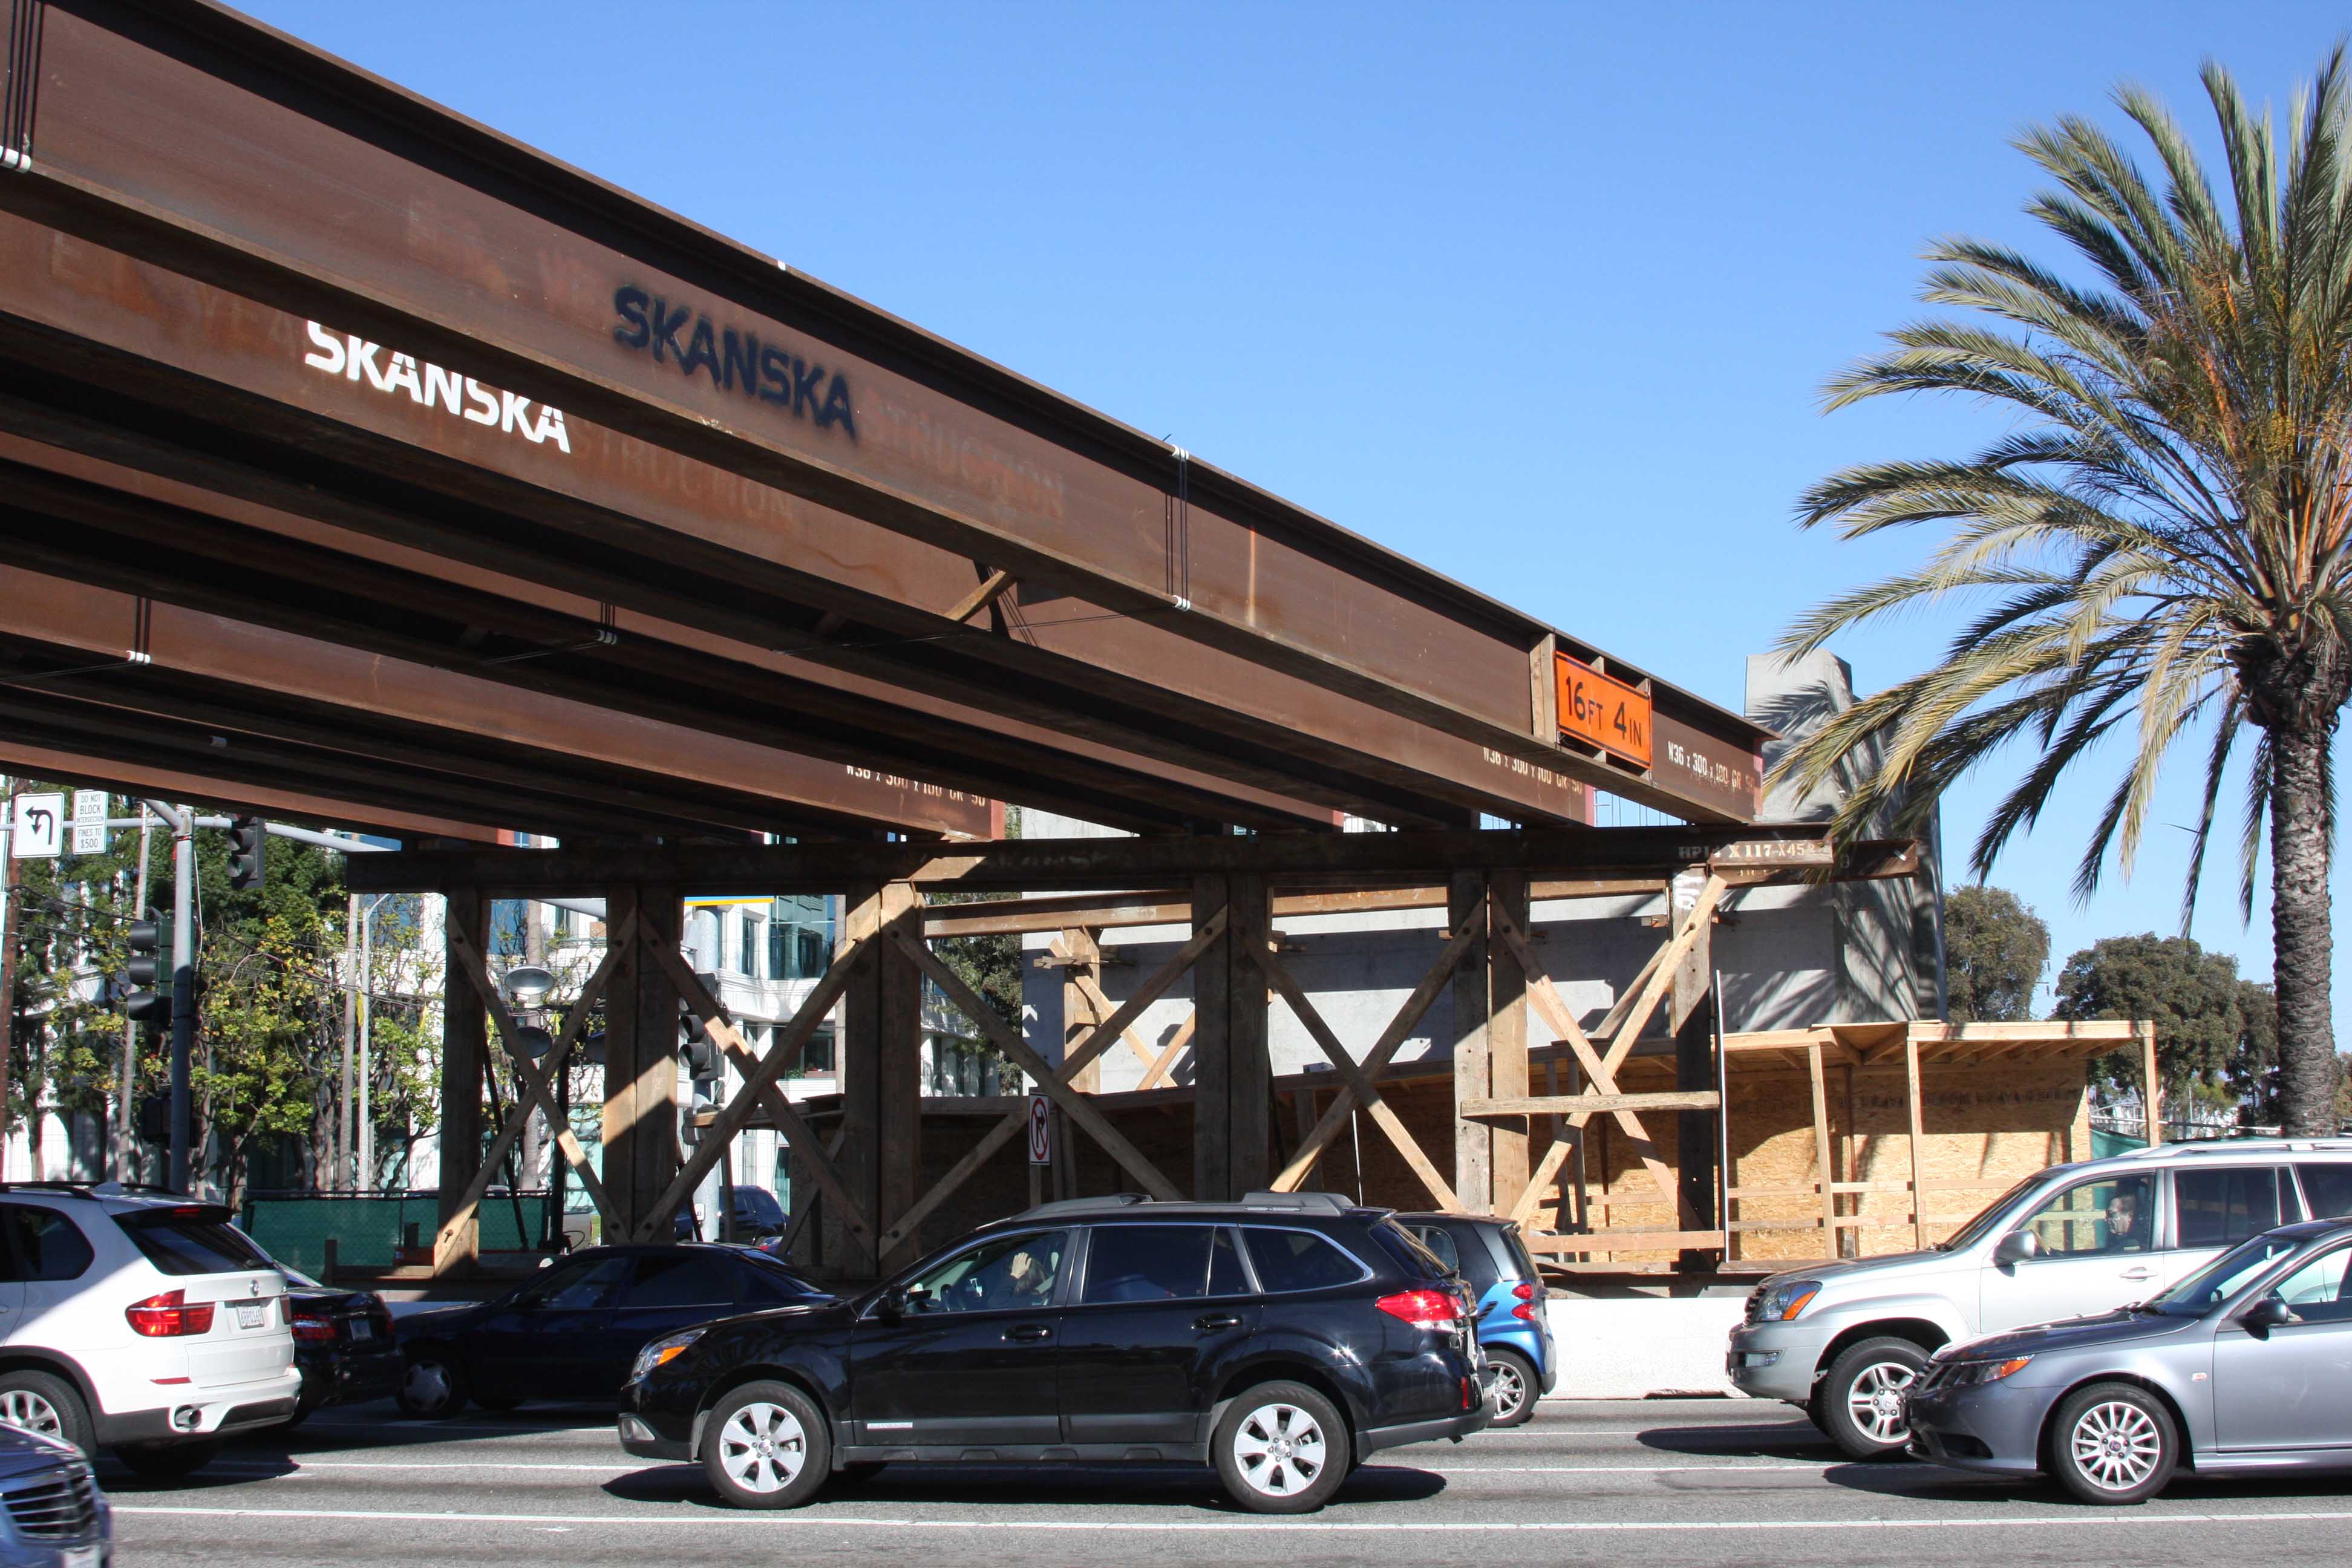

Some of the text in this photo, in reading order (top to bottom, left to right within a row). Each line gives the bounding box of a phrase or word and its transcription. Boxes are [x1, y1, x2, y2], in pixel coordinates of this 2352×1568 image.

[614, 285, 856, 440] SKANSKA
[305, 320, 570, 454] SKANSKA
[1668, 741, 1684, 765] W36
[1693, 753, 1708, 776] 300
[1732, 769, 1741, 789] GR
[80, 805, 101, 814] BLOCK
[81, 838, 98, 848] $500
